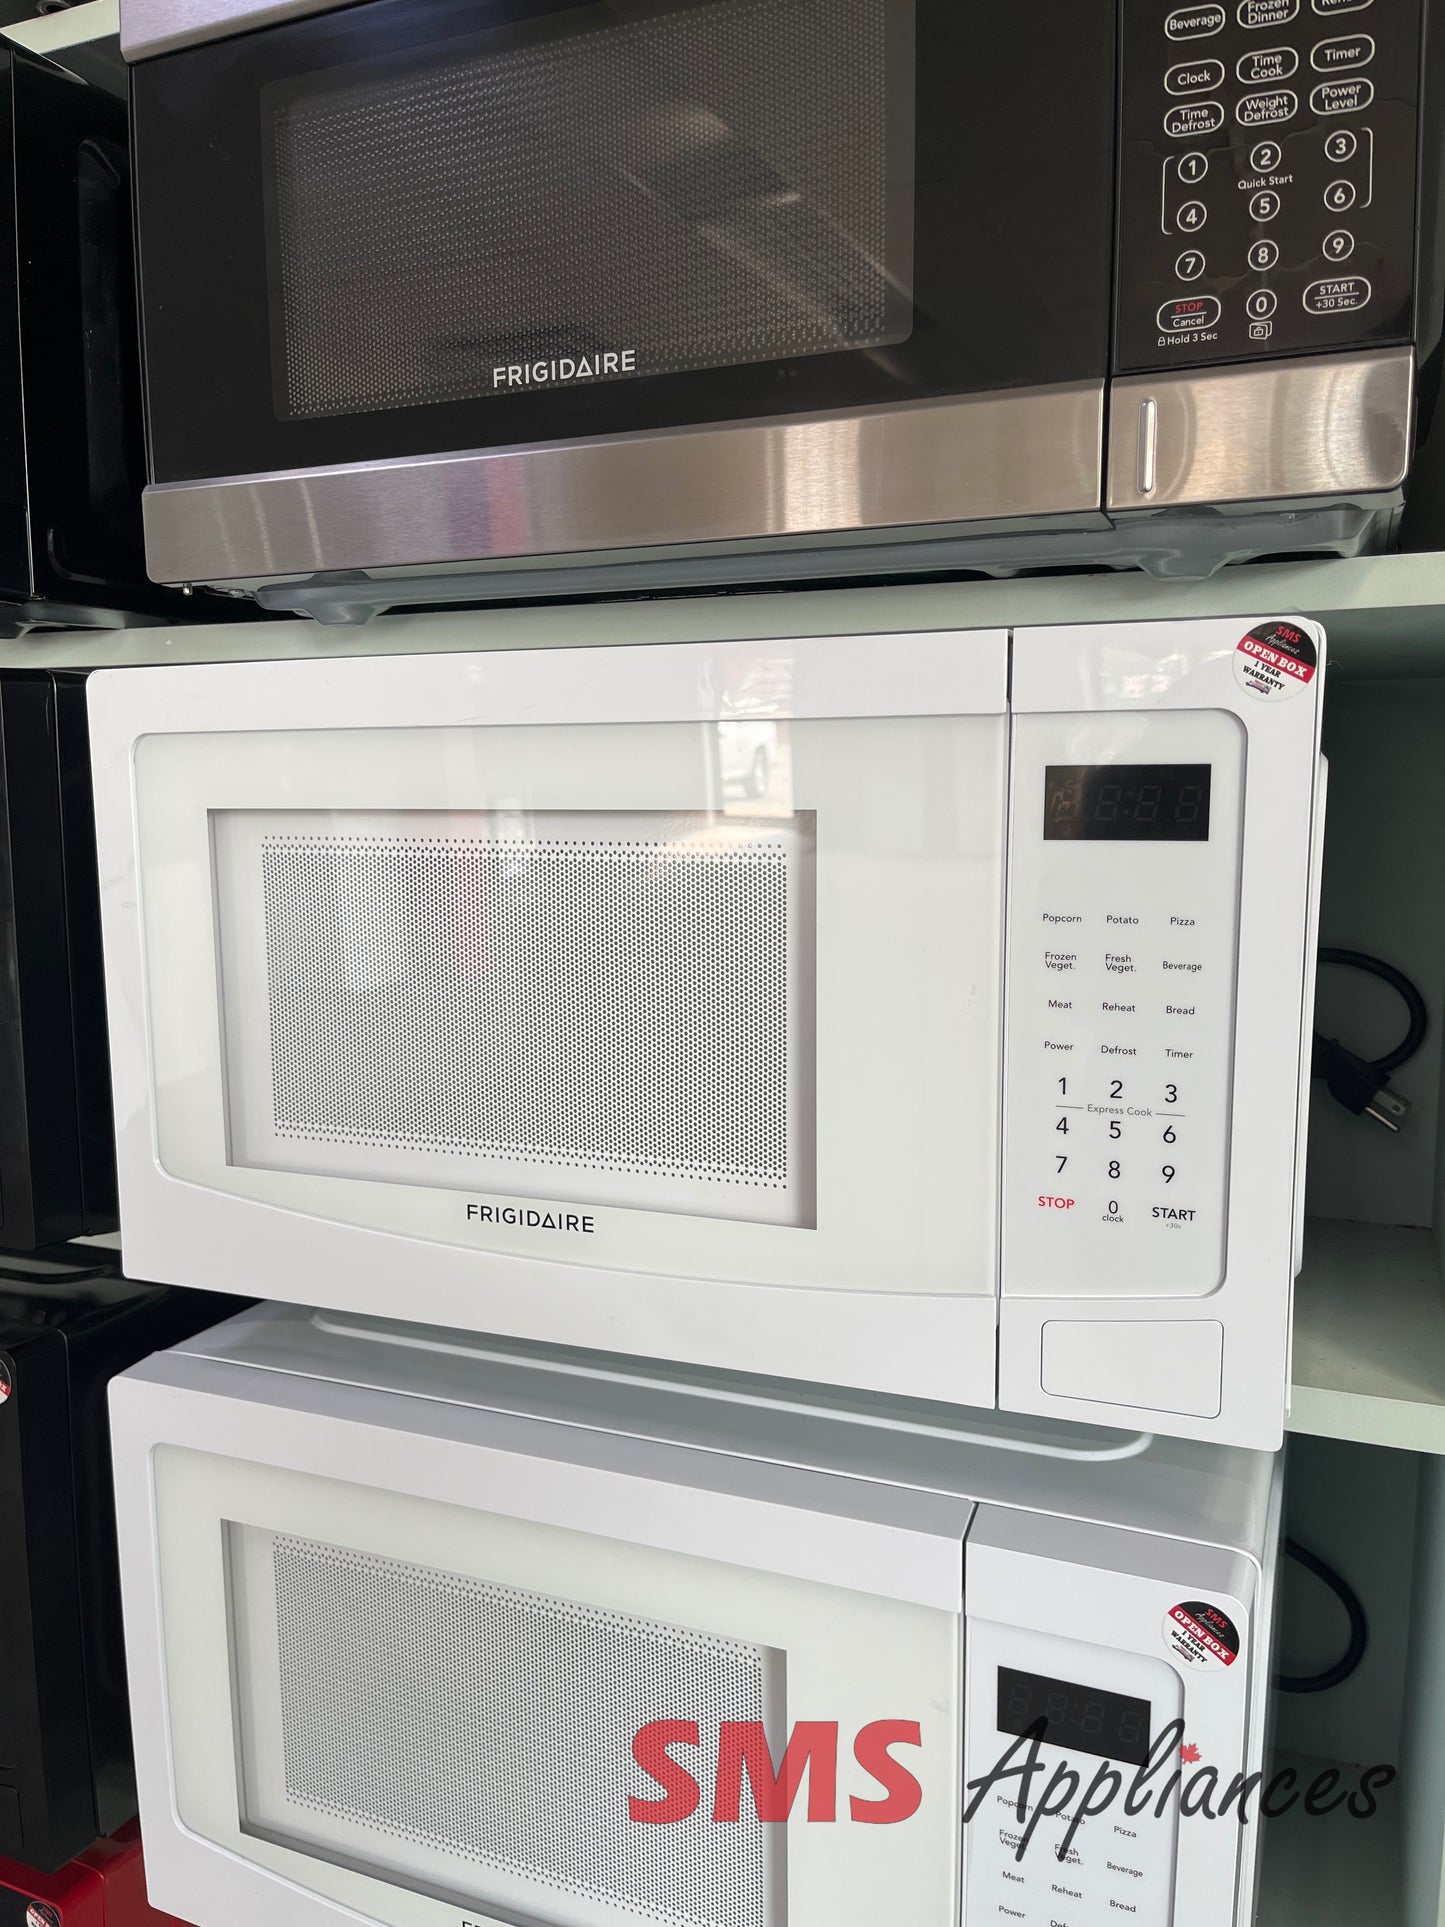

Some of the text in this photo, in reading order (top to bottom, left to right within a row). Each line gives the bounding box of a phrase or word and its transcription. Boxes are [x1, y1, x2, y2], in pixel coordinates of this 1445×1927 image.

[1170, 13, 1222, 31] Beverage
[1248, 9, 1288, 24] Dinner
[1252, 54, 1282, 66] Time
[1325, 47, 1361, 62] Timer
[1178, 71, 1210, 85] Clock
[1251, 65, 1282, 78] Cook
[1322, 84, 1361, 99] Power
[1246, 96, 1288, 111] Weight
[1325, 97, 1358, 110] Level
[1180, 108, 1208, 121] Time
[1244, 107, 1288, 122] Defrost
[1172, 118, 1215, 134] Defrost
[1335, 138, 1346, 154] 3
[1261, 149, 1271, 165] 2
[1189, 160, 1196, 176] 1
[1238, 174, 1293, 190] Quick Start
[1334, 188, 1345, 203] 6
[1260, 198, 1270, 214] 5
[1186, 209, 1198, 224] 4
[1333, 238, 1344, 254] 9
[1258, 248, 1268, 264] 8
[1186, 258, 1196, 273] 7
[1320, 282, 1354, 294] START
[1176, 302, 1203, 314] STOP
[1256, 297, 1266, 312] 0
[1316, 299, 1335, 309] +30
[1173, 316, 1204, 328] Cancel
[1168, 332, 1218, 346] Hold 3 Sec
[493, 350, 636, 388] FRIGIDAIRE
[1276, 626, 1302, 644] SMS
[1244, 641, 1308, 678] OPEN BOX
[1243, 666, 1285, 690] WARRANTY
[1260, 663, 1282, 678] YEAR
[1043, 913, 1082, 924] Popcorn
[1106, 915, 1139, 924] Potato
[1170, 917, 1195, 926] Pizza
[1045, 952, 1076, 961] Frozen
[1106, 954, 1132, 962] Fresh
[1045, 961, 1076, 972] Veget.
[1106, 963, 1136, 974] Veget.
[1163, 961, 1202, 972] Beverage
[1048, 1000, 1072, 1009] Meat
[1102, 1003, 1136, 1012] Reheat
[1166, 1006, 1194, 1015] Bread
[1044, 1041, 1074, 1050] Power
[1101, 1046, 1136, 1055] Defrost
[1165, 1049, 1193, 1058] Timer
[1058, 1077, 1066, 1095] 1
[1110, 1080, 1123, 1098] 2
[1164, 1084, 1177, 1102] 3
[1088, 1104, 1152, 1117] Express Cook
[1056, 1117, 1069, 1134] 4
[1109, 1121, 1121, 1138] 5
[1163, 1125, 1176, 1144] 6
[1056, 1156, 1068, 1173] 7
[1108, 1160, 1120, 1178] 8
[1162, 1166, 1175, 1183] 9
[1038, 1196, 1074, 1208] STOP
[1108, 1201, 1118, 1214] 0
[467, 1204, 594, 1233] FRIGIDAIRE
[1102, 1214, 1124, 1222] clock
[1152, 1207, 1196, 1221] START
[1205, 1608, 1228, 1628] SMS
[1174, 1610, 1230, 1660] OPEN BOX
[1172, 1630, 1208, 1662] WARRANTY
[1188, 1634, 1206, 1652] YEAR
[1000, 1829, 1028, 1842] Frozen
[1114, 1826, 1136, 1838] Pizza
[1002, 1871, 1025, 1884] Meat
[1106, 1862, 1144, 1878] Beverage
[1052, 1884, 1082, 1899] Reheat
[998, 1905, 1026, 1918] Power
[1110, 1900, 1136, 1913] Bread
